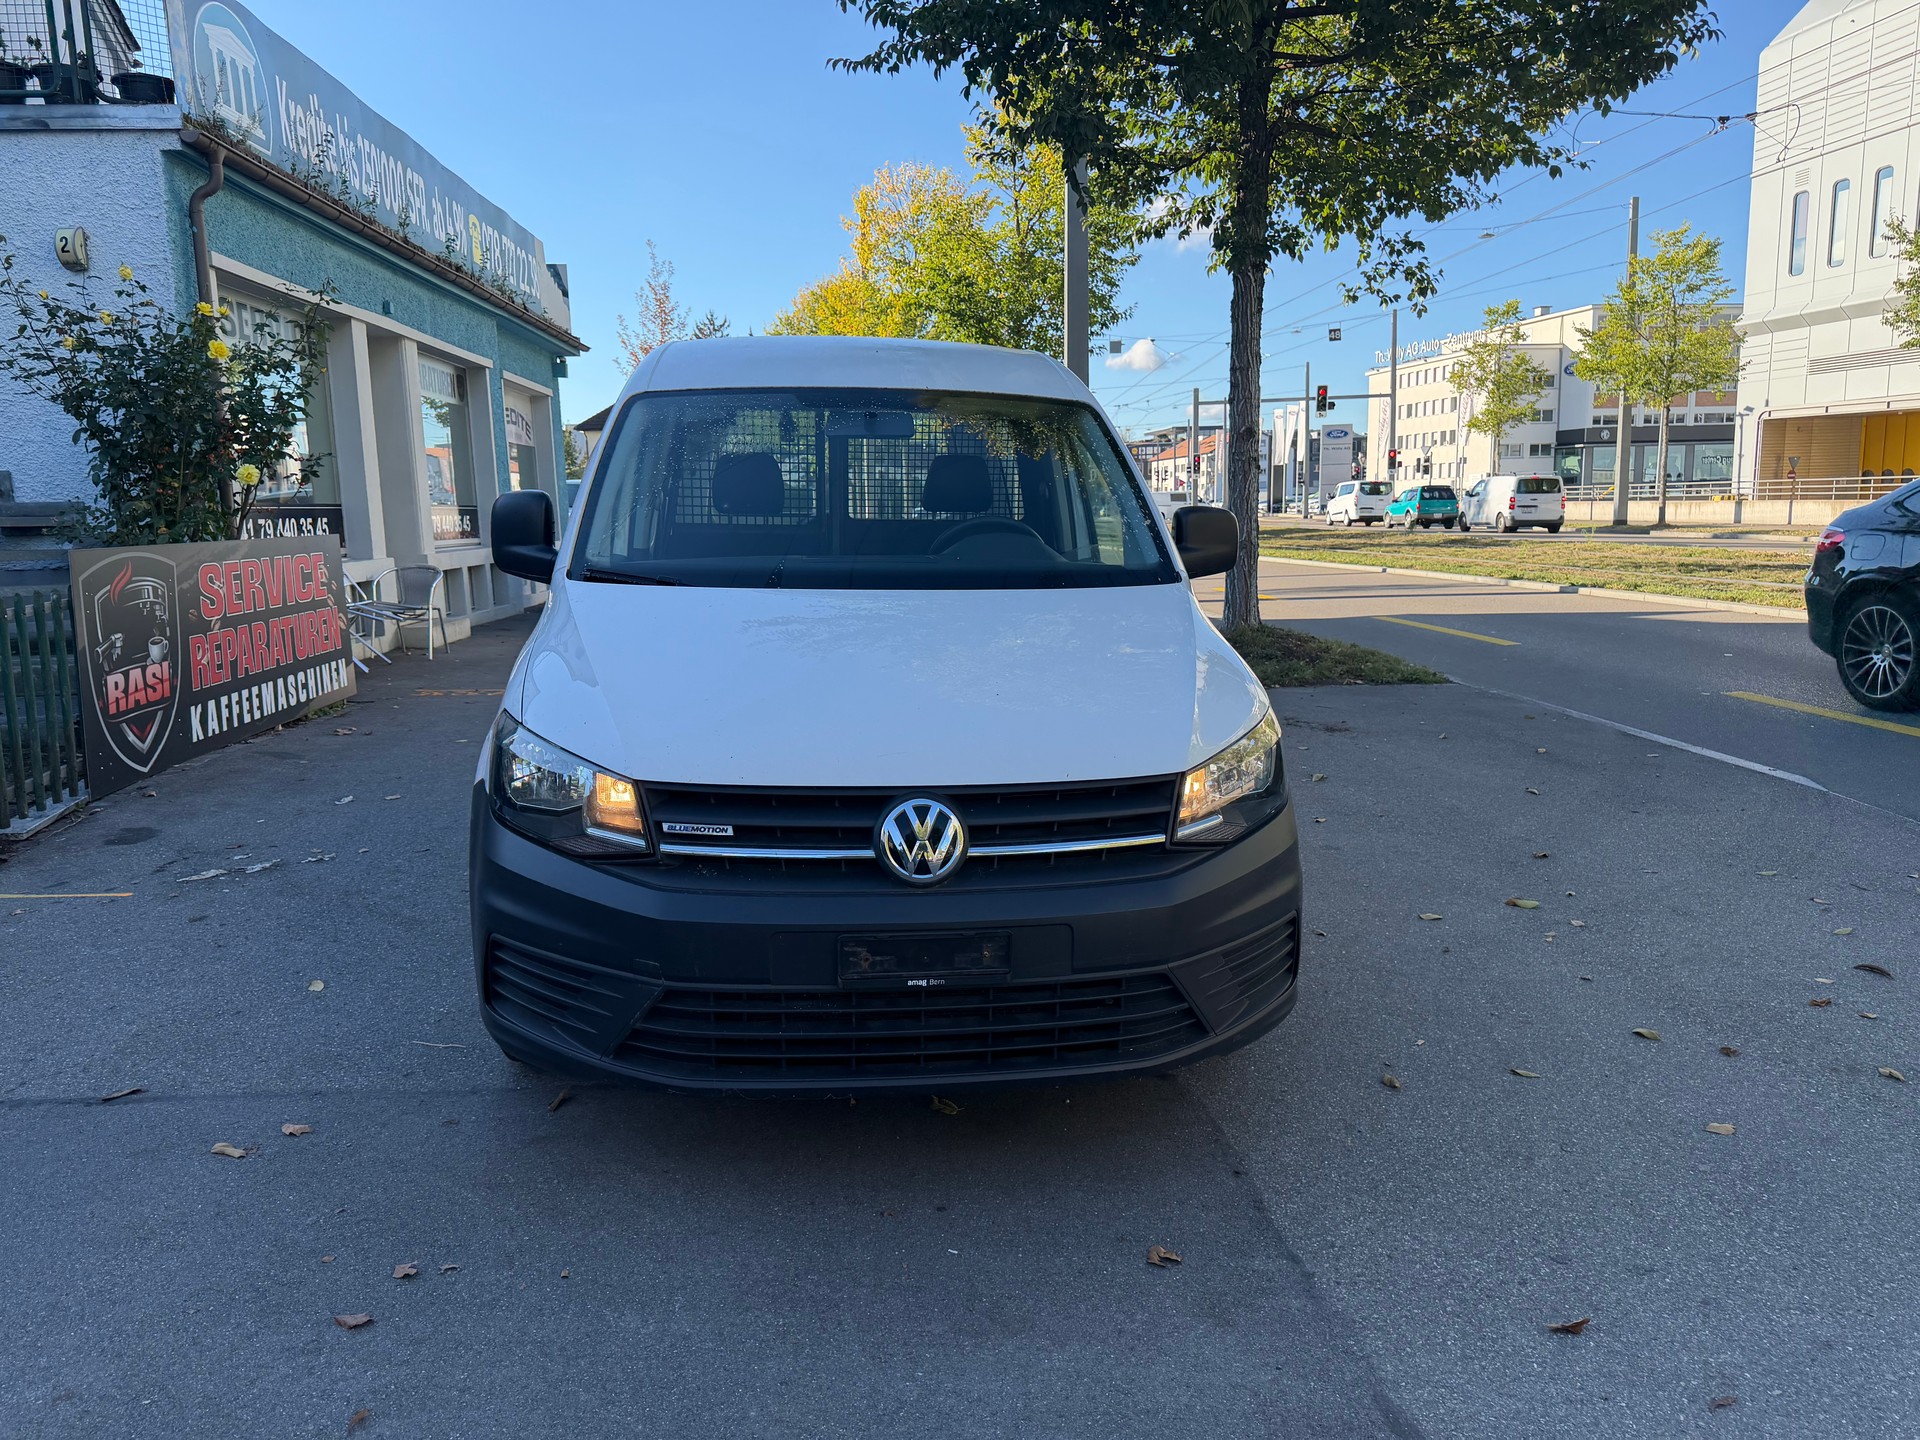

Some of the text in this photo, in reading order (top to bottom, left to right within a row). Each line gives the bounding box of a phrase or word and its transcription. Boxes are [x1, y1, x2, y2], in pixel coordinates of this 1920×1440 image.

[275, 74, 338, 178] Kredite
[336, 112, 360, 190] bis
[432, 186, 446, 243] ab
[60, 236, 70, 254] 2
[516, 246, 530, 294] 22
[1329, 331, 1341, 340] 48
[1387, 345, 1405, 361] Wlly
[1405, 341, 1419, 358] AG
[300, 517, 314, 537] 35
[463, 515, 471, 532] 45
[198, 552, 327, 620] SERVICE
[188, 605, 342, 692] REPARATUREN
[106, 661, 171, 716] RASI
[190, 658, 348, 743] KAFFEEMASCHINEN
[666, 824, 729, 834] BLUEMOTION
[907, 978, 945, 987] amag Bern
